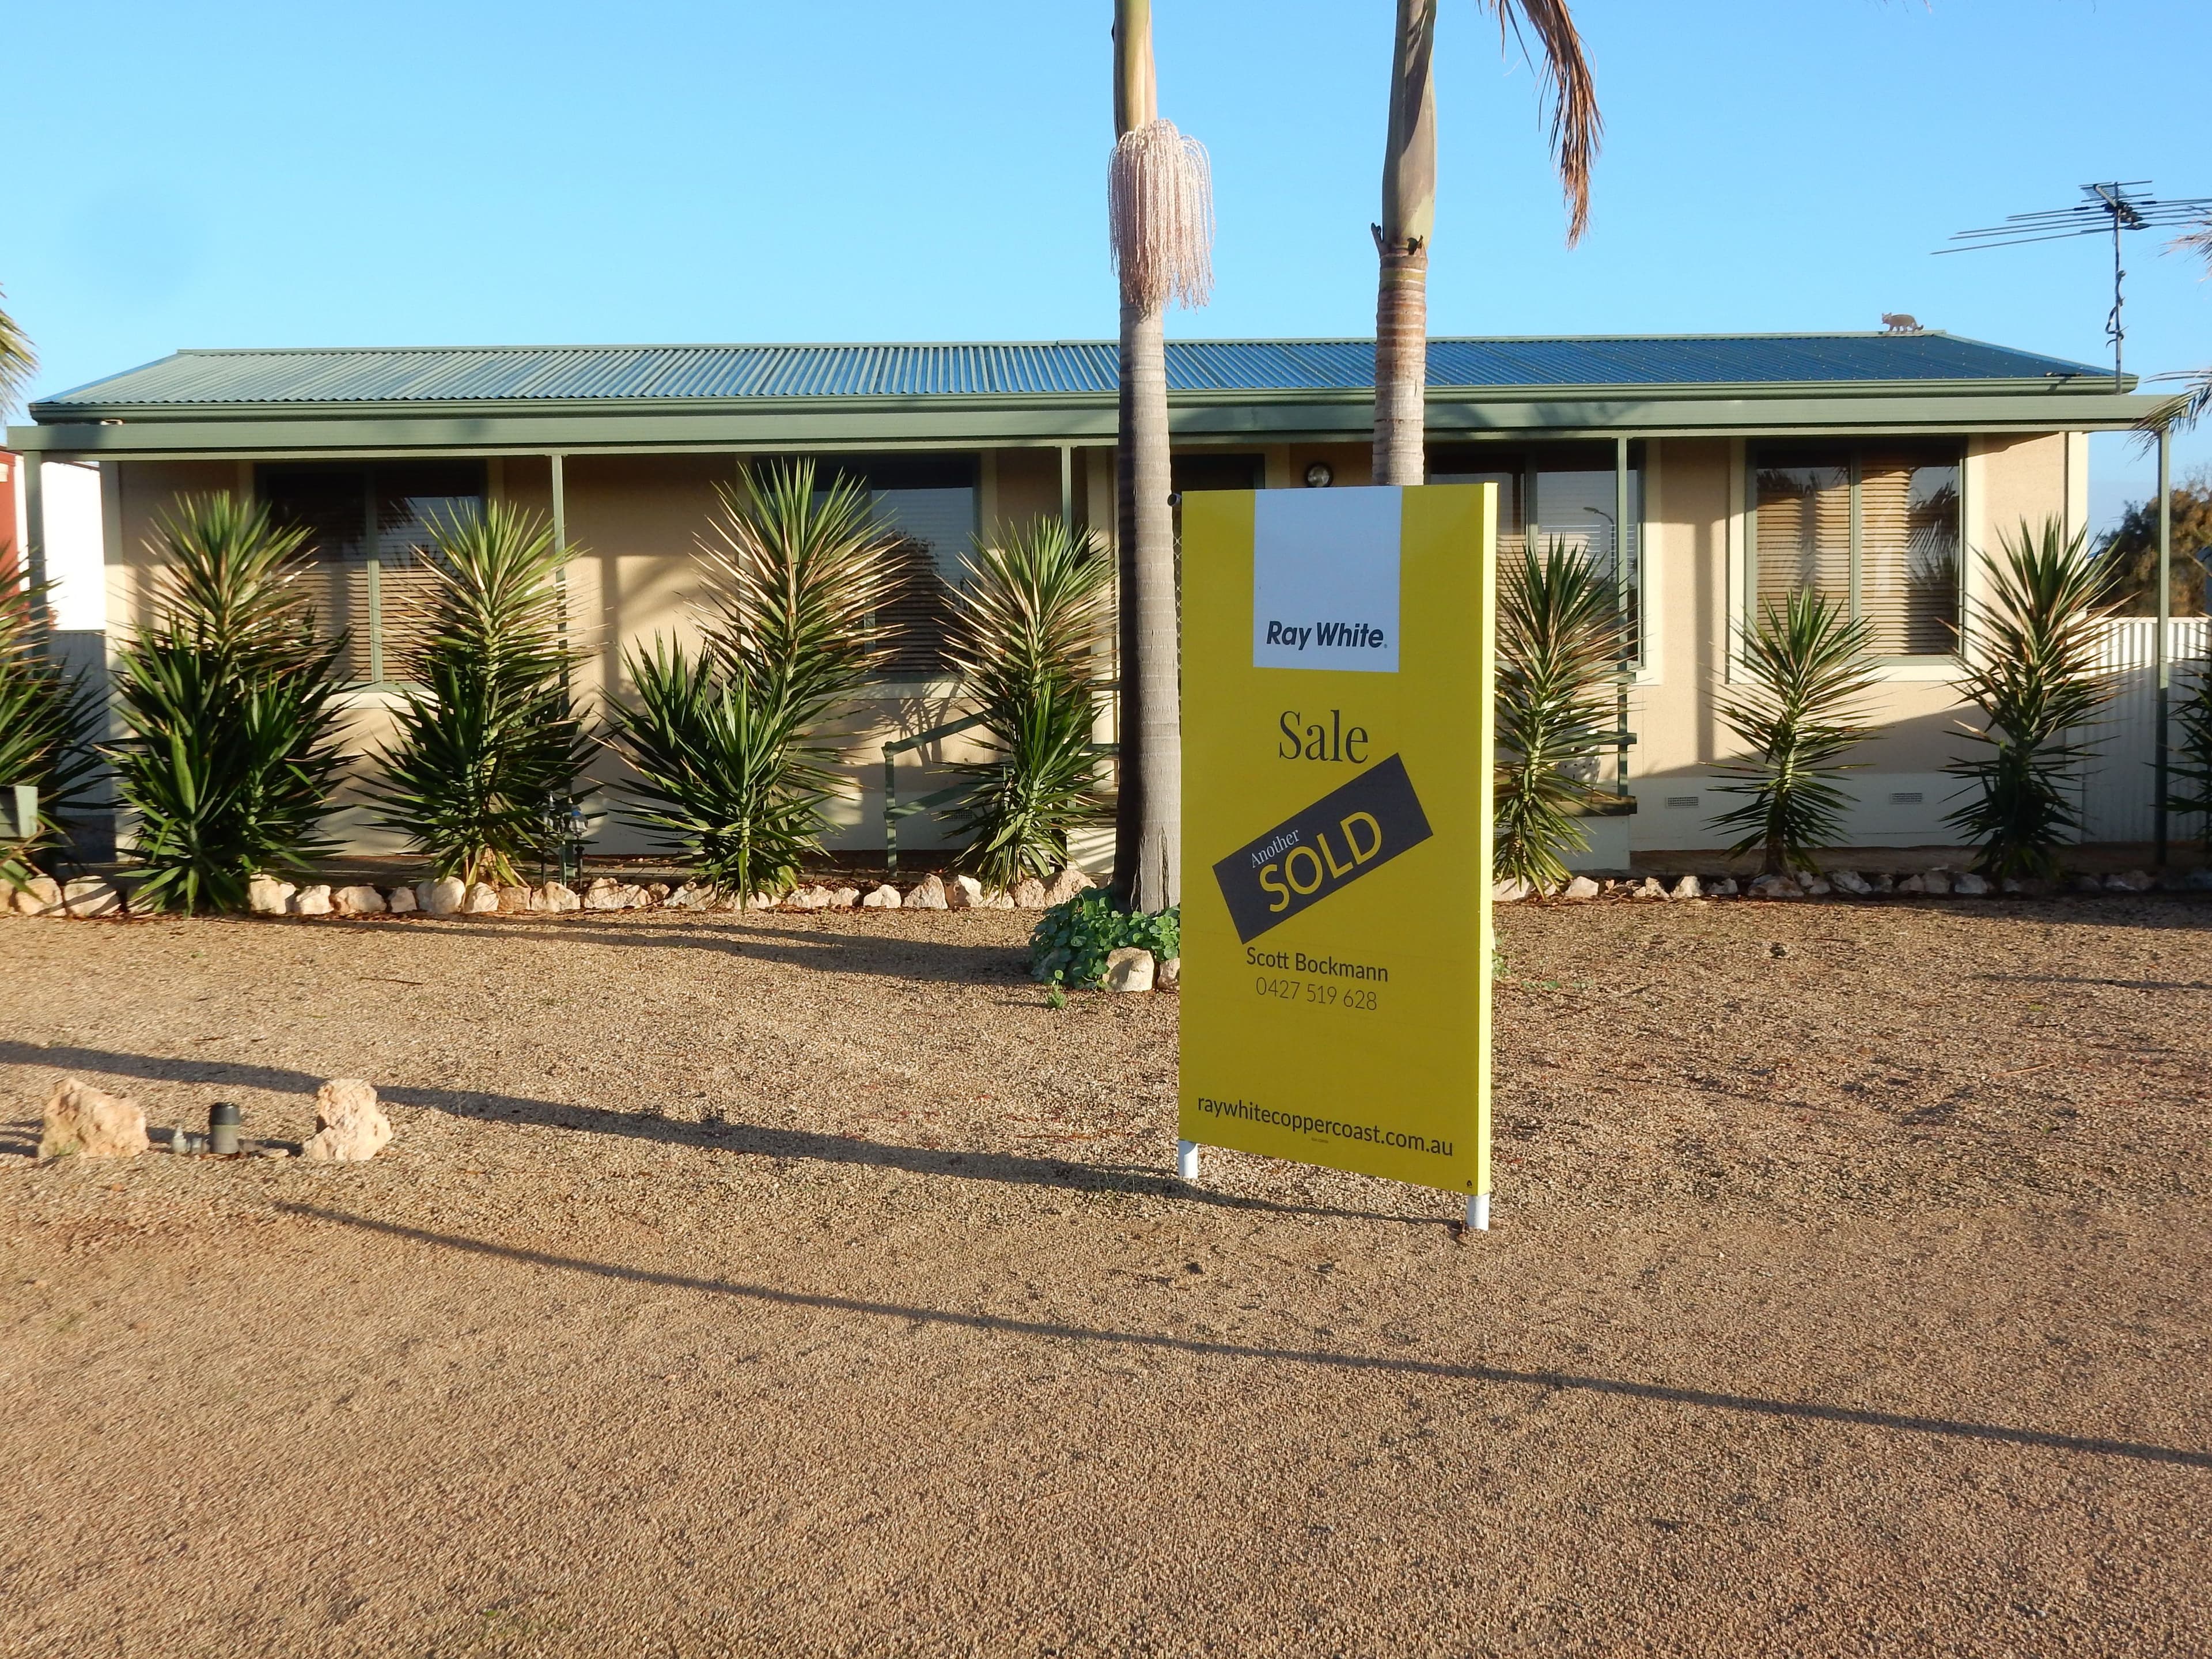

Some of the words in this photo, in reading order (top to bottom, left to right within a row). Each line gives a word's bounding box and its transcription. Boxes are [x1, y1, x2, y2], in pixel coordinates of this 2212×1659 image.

[1266, 620, 1312, 651] Ray
[1317, 622, 1384, 648] White
[1279, 709, 1369, 764] Sale
[1250, 829, 1300, 869] Another
[1259, 811, 1382, 912] SOLD
[1246, 946, 1290, 970] Scott
[1296, 952, 1388, 982] Bockmann
[1256, 976, 1301, 1000] 0427
[1306, 983, 1337, 1005] 519
[1343, 988, 1377, 1011] 628
[1198, 1096, 1453, 1157] raywhitecoppercoast.com.au
